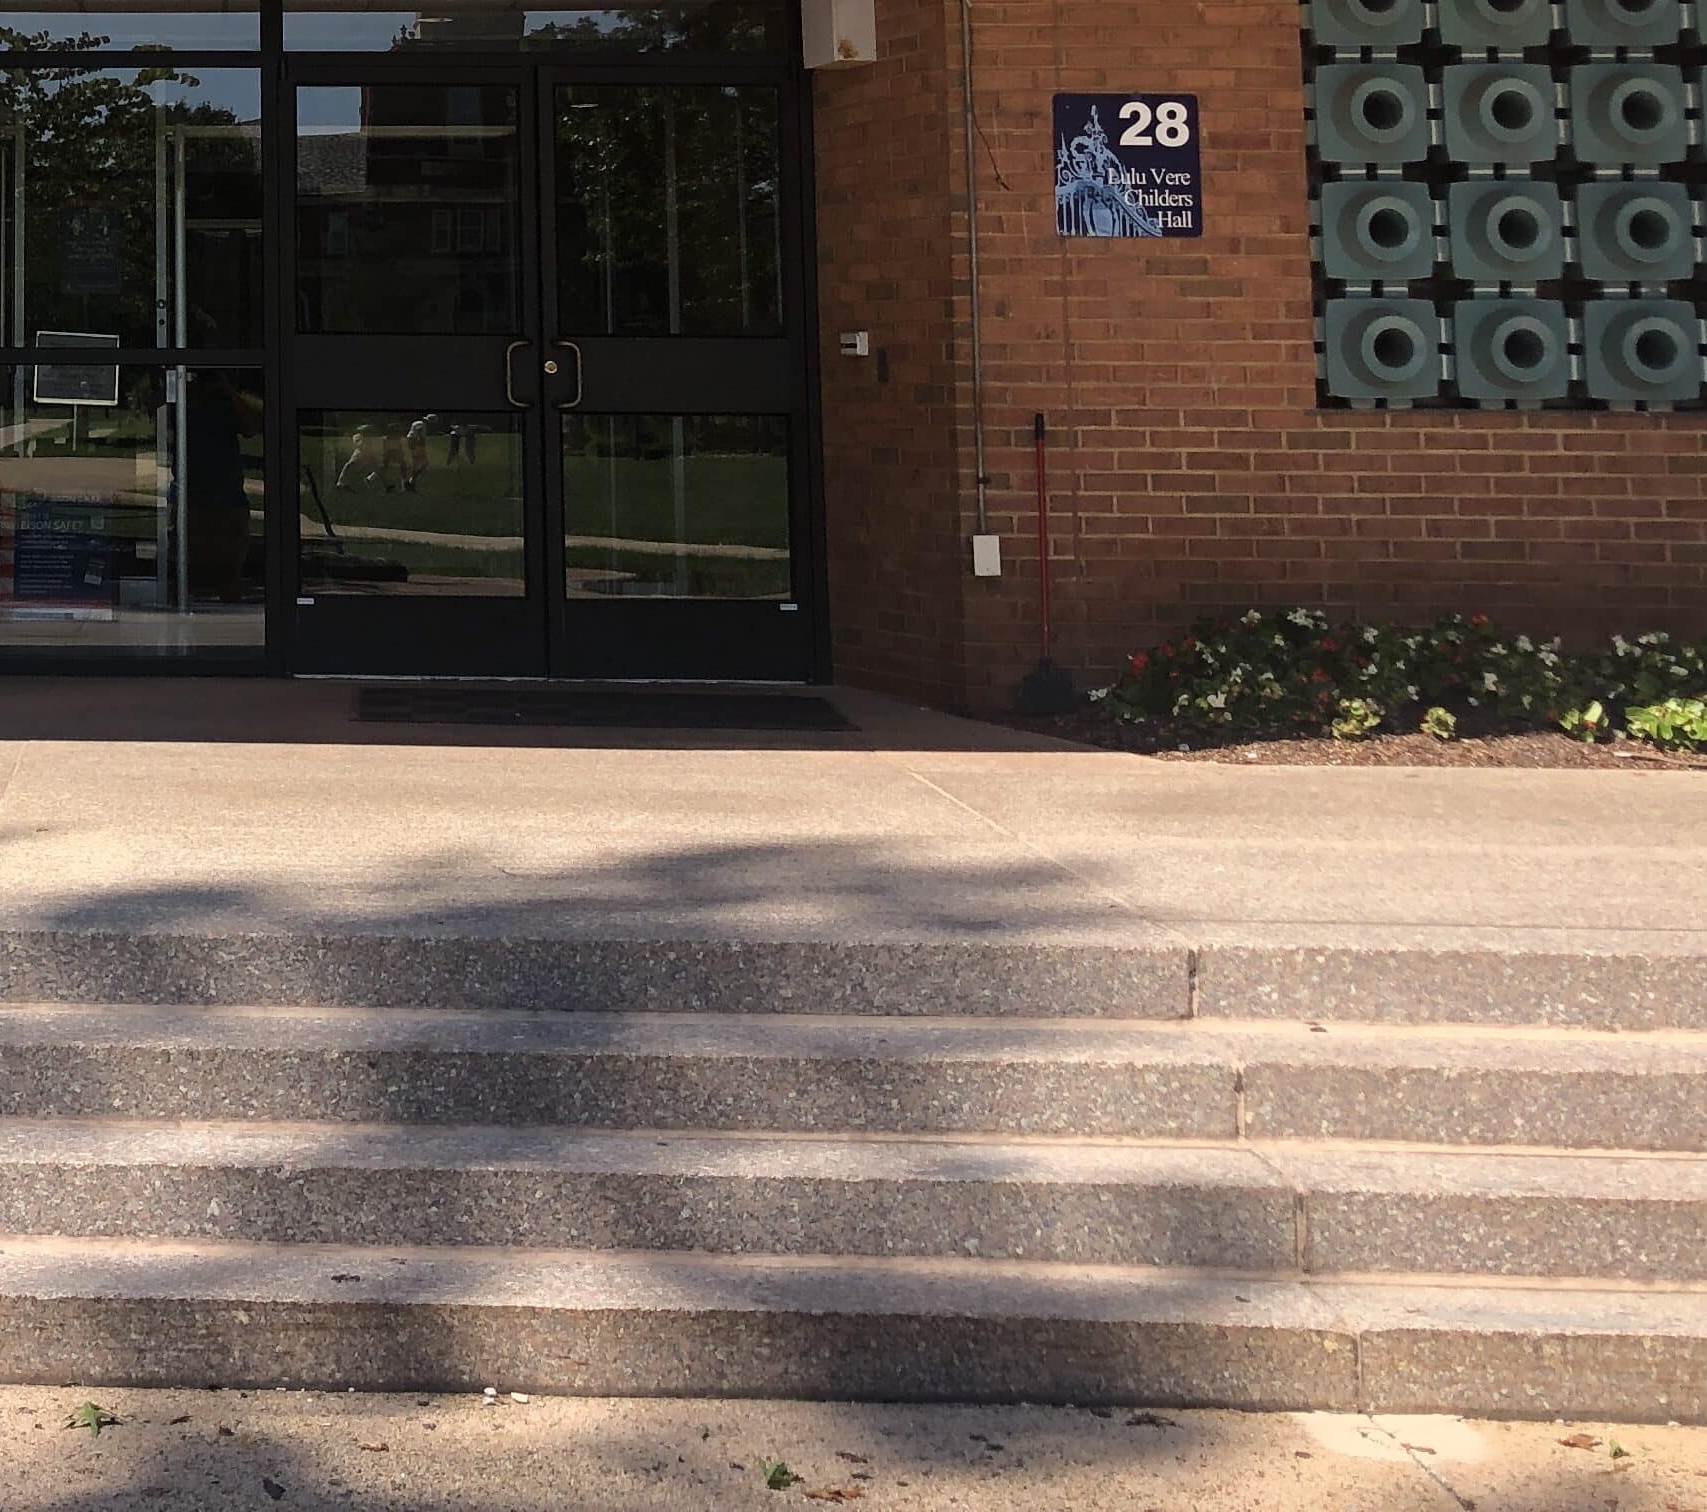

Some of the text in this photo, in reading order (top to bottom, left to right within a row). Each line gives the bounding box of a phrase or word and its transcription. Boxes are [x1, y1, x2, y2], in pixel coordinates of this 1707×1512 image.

[1118, 101, 1190, 148] 28
[1108, 168, 1191, 185] Lulu Vere
[1124, 189, 1194, 207] Childers
[1157, 210, 1193, 228] Hall
